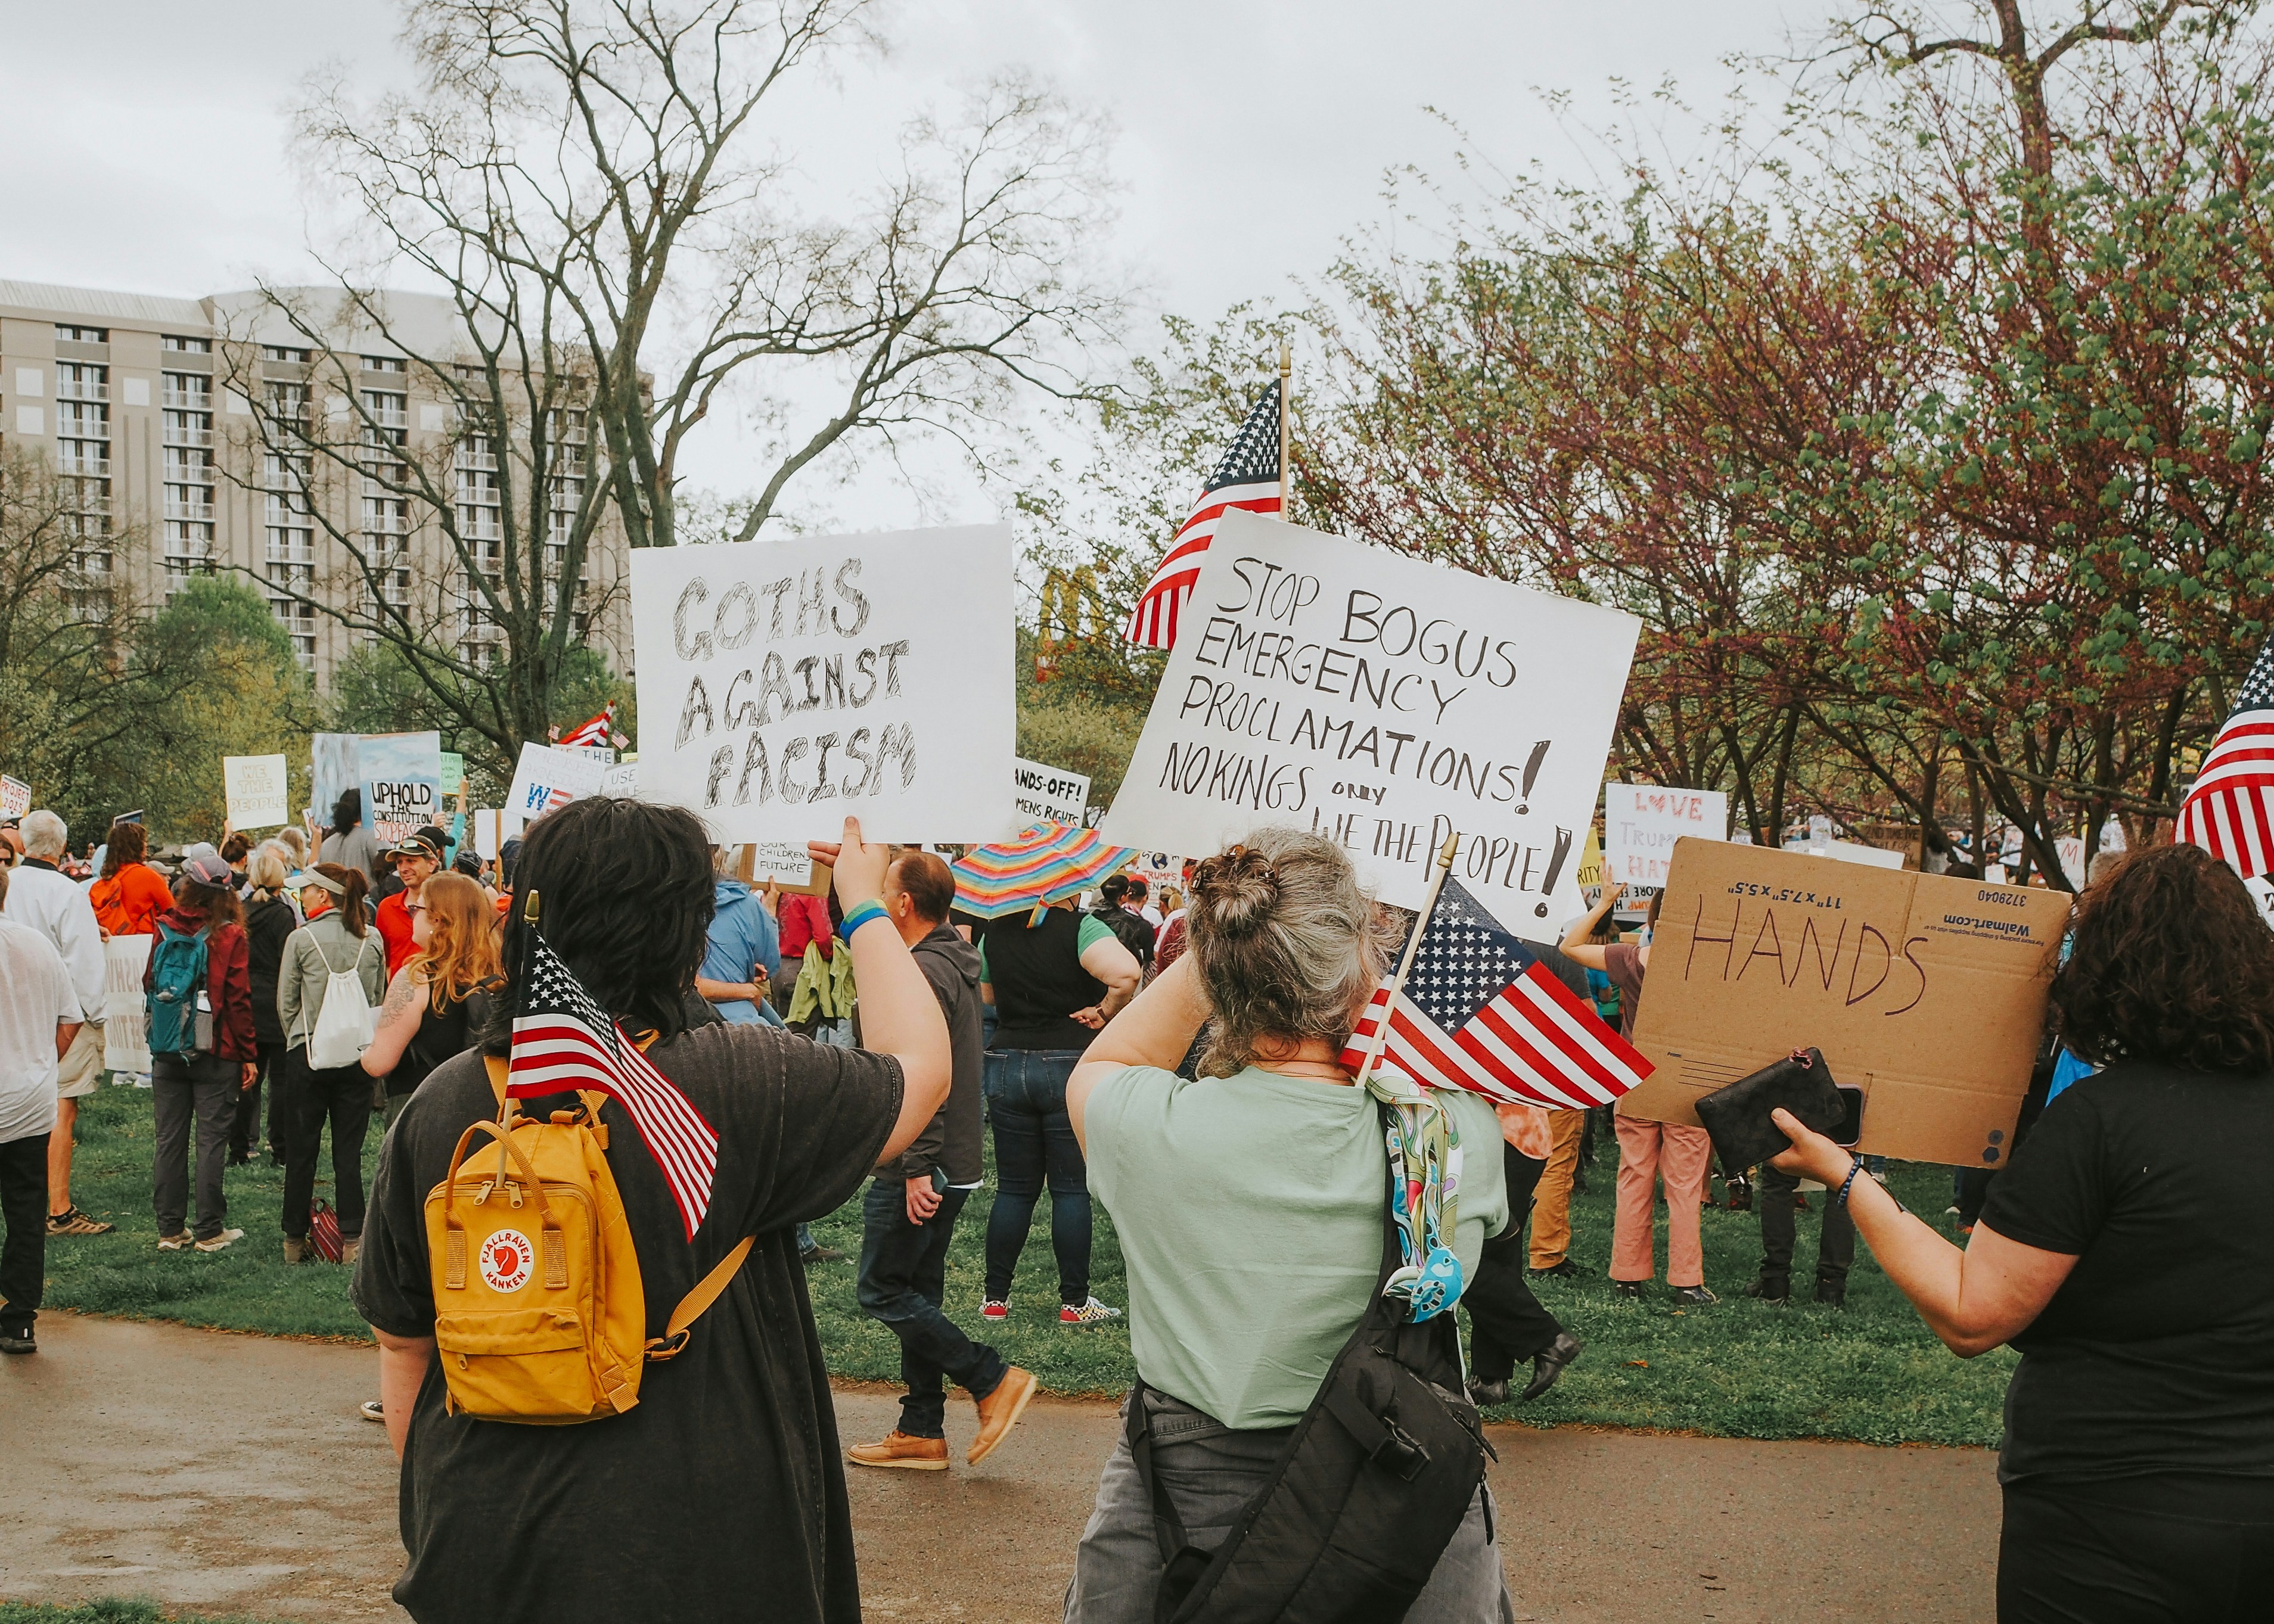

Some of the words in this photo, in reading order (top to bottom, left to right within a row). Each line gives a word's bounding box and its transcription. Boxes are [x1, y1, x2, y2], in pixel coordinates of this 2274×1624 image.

[673, 558, 871, 662] GOTHS
[1216, 556, 1319, 626] STOP
[1339, 589, 1517, 688] BOGUS
[1196, 617, 1467, 724] EMERGENCY
[675, 639, 910, 752] AGAINST
[1179, 674, 1551, 815] PROCLAMATIONS!
[242, 764, 267, 778] WE
[704, 721, 917, 809] FACISM
[238, 779, 273, 794] THE
[371, 782, 431, 805] UPHOLD
[1015, 768, 1082, 802] ANDS-OFF!
[4, 798, 23, 813] 2025
[229, 795, 287, 813] PEOPLE
[1015, 798, 1042, 816] MENS
[374, 810, 433, 824] CONSTITUTION
[1373, 819, 1425, 863] THE
[1620, 822, 1676, 847] TRUM
[760, 861, 807, 873] FUTURE
[1142, 870, 1178, 881] TRUMP'S
[1577, 865, 1599, 884] RITY
[1628, 855, 1672, 878] HAT
[1977, 889, 2027, 907] 3729040
[1943, 914, 2030, 937] Walmart.com
[1685, 894, 1928, 1016] HANDS
